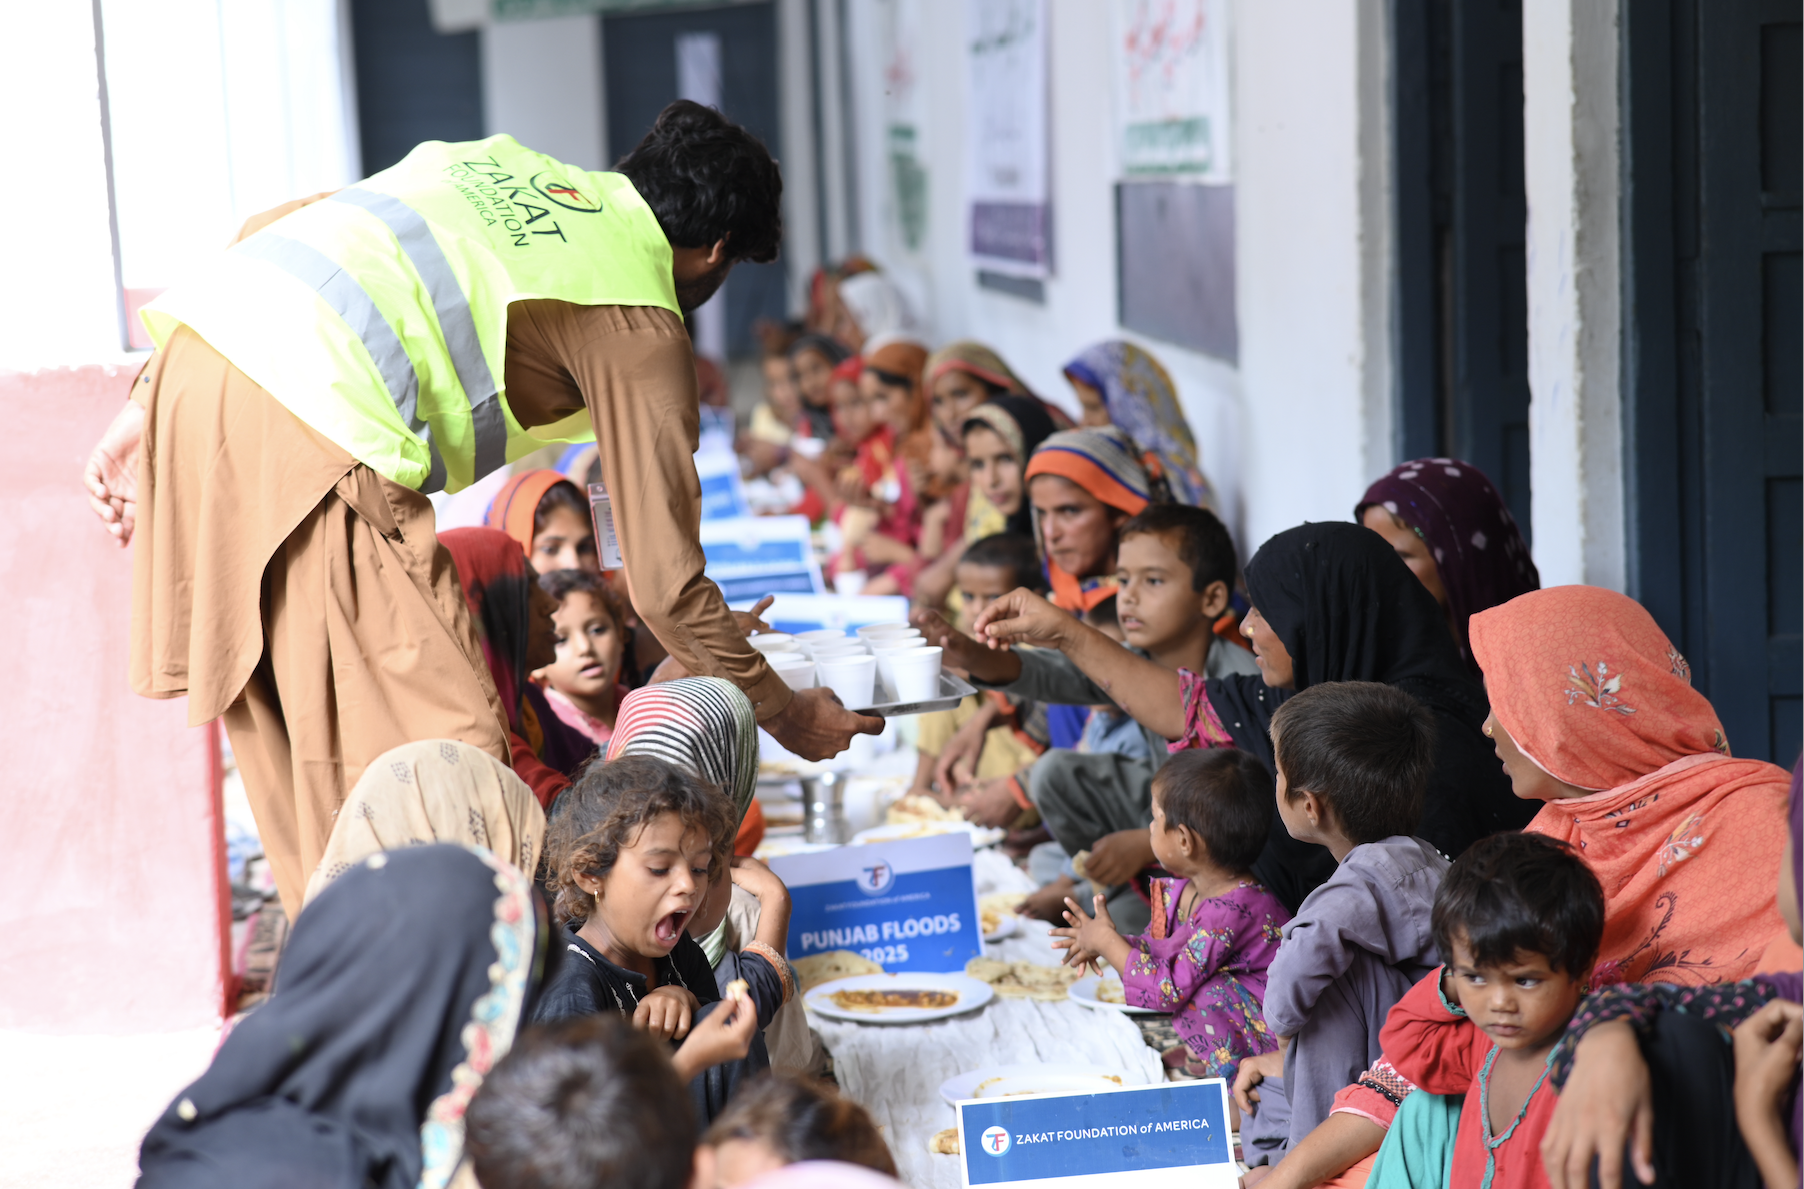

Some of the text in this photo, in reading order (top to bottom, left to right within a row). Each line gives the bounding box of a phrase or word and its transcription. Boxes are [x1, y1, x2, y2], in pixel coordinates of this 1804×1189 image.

[442, 164, 530, 247] FOUNDATION
[452, 183, 497, 227] AMERICA
[462, 156, 567, 243] ZAKAT
[801, 912, 962, 950] PUNJAB FLOODS
[1016, 1131, 1055, 1145] ZAKAT
[1057, 1124, 1138, 1142] FOUNDATION
[1140, 1122, 1153, 1134] of
[1155, 1118, 1209, 1133] AMERICA
